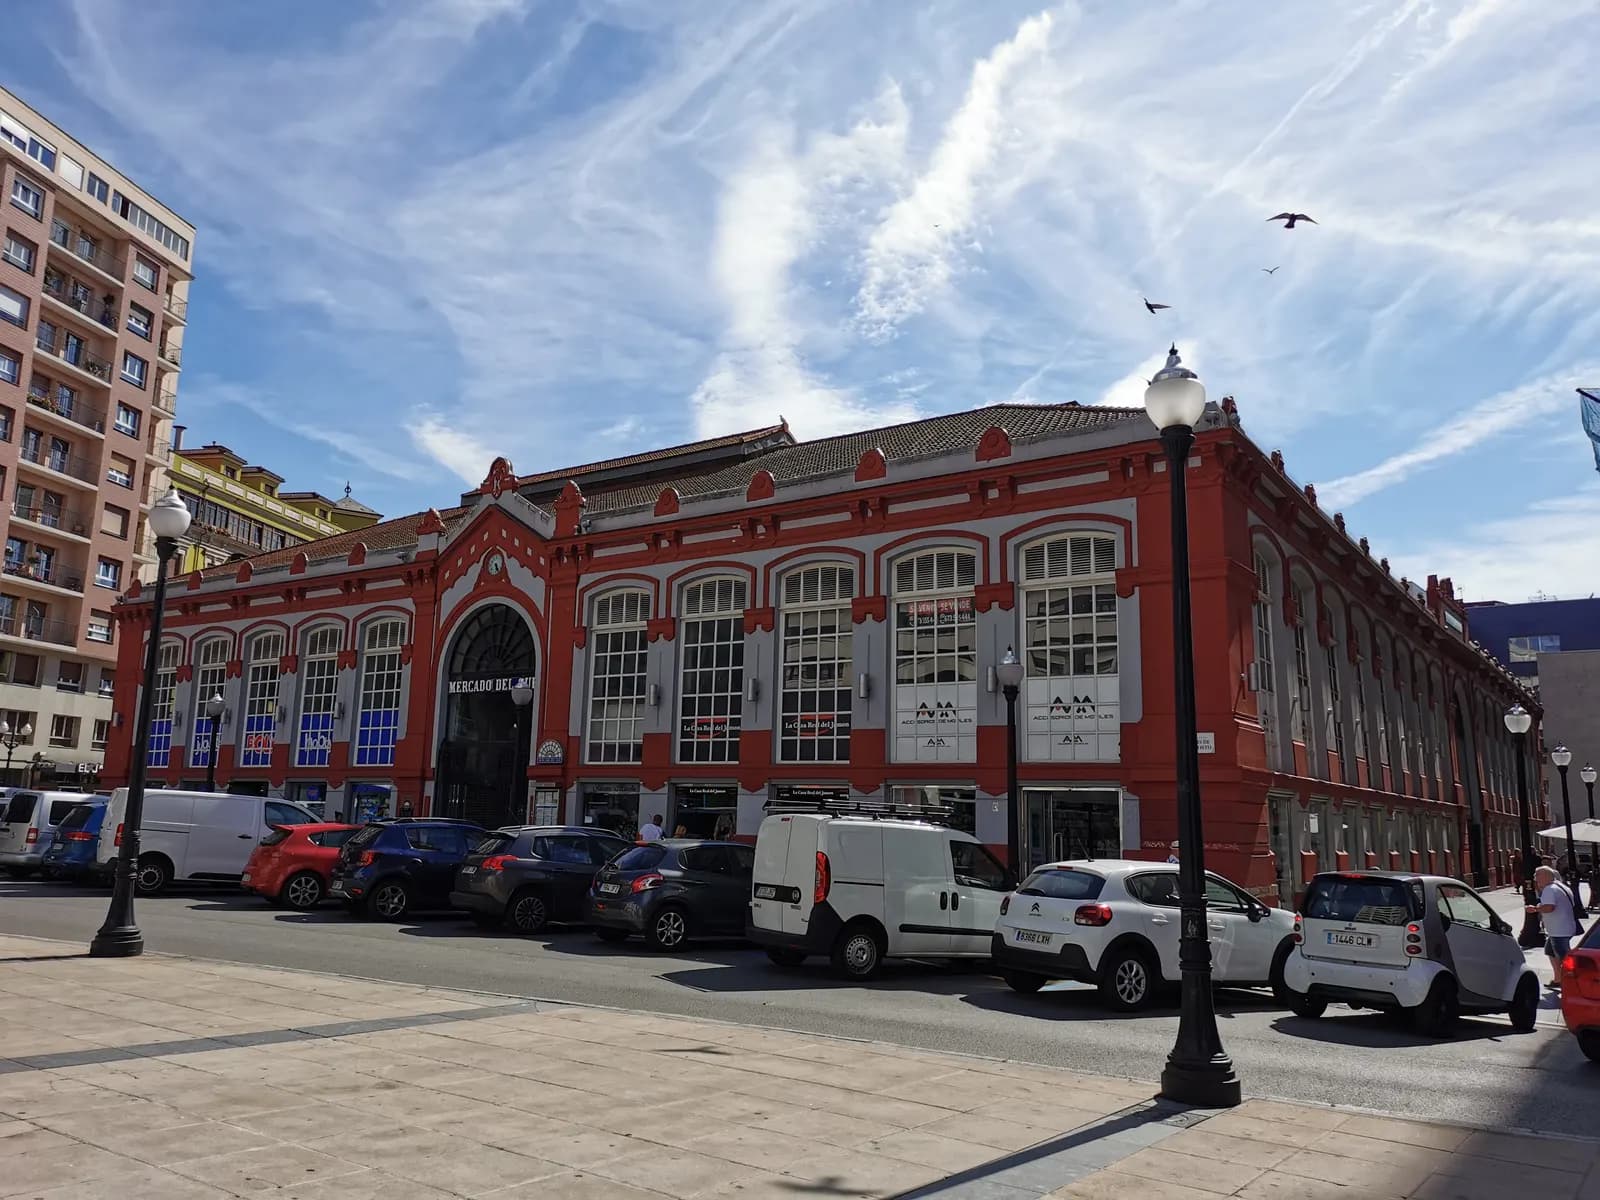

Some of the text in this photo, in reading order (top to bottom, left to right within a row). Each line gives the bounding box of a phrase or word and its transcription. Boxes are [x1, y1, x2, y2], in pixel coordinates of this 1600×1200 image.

[949, 599, 971, 610] VNDE
[449, 680, 492, 693] MERCADO
[496, 679, 512, 690] DEL
[79, 763, 89, 773] EL
[1335, 934, 1354, 945] 1446
